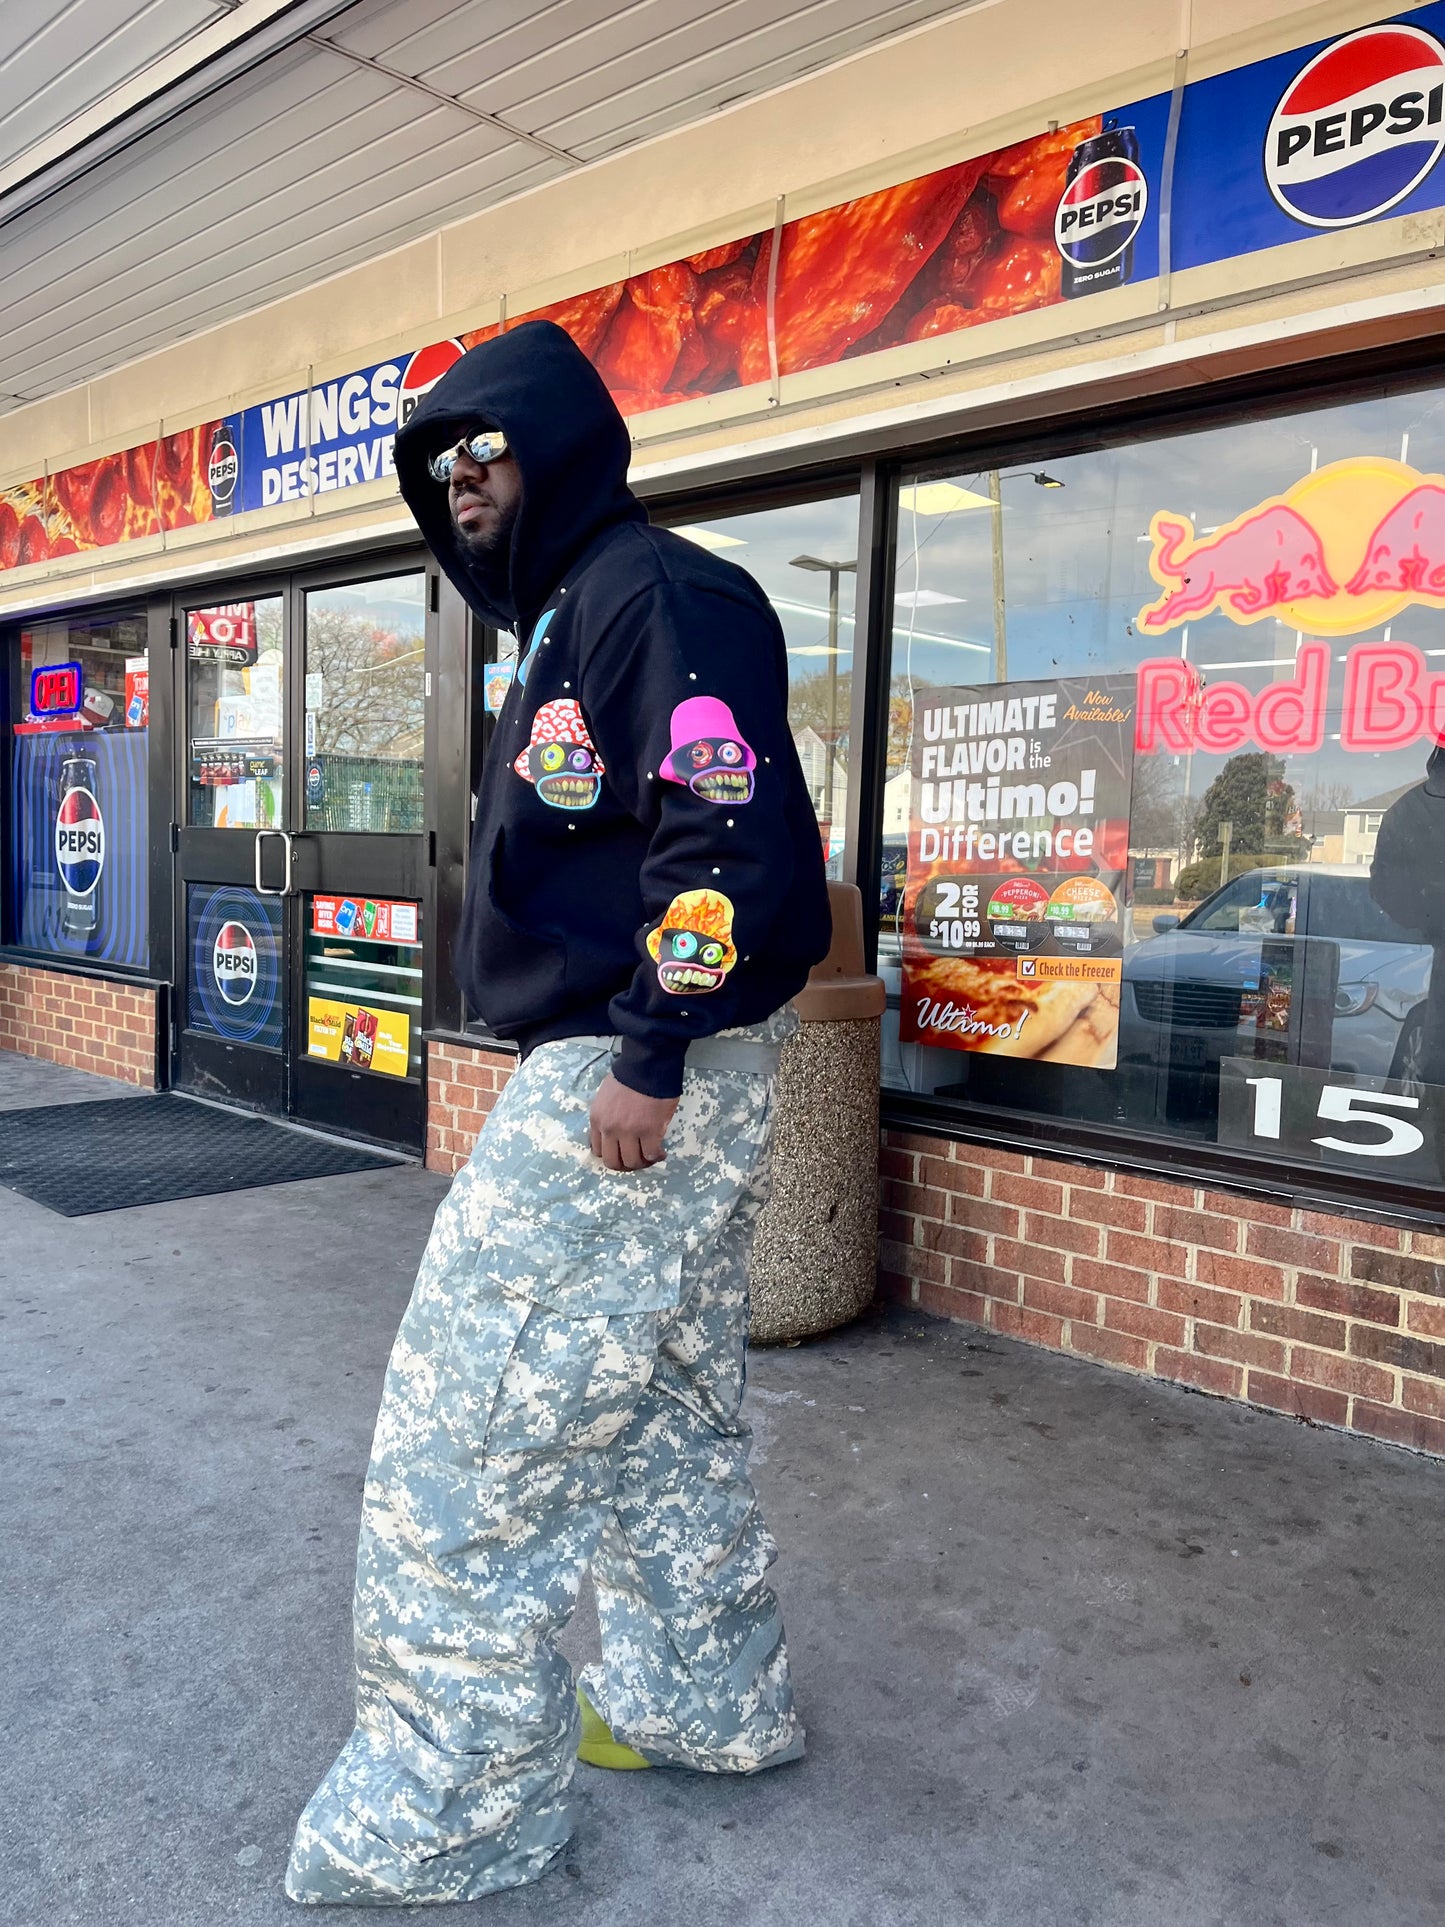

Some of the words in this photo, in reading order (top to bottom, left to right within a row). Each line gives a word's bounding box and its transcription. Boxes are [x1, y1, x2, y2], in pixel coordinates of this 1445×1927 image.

[1277, 82, 1443, 167] PEPSI
[1061, 190, 1141, 234] PEPSI
[1074, 272, 1093, 284] ZERO
[1094, 265, 1121, 279] SUGAR
[261, 364, 401, 458] WINGS
[211, 462, 236, 480] PEPSI
[35, 670, 78, 710] OPEN
[1083, 690, 1114, 705] Now
[1134, 640, 1331, 755] Red
[923, 694, 1057, 741] ULTIMATE
[1063, 704, 1132, 722] Available!
[921, 737, 1026, 778] FLAVOR
[1029, 739, 1041, 753] is
[1029, 754, 1051, 769] the
[920, 769, 1096, 824] Ultimo!
[58, 830, 101, 853] PEPSI
[919, 824, 1093, 862] Difference
[935, 882, 960, 917] 2
[962, 884, 979, 918] FOR
[1066, 887, 1101, 897] CHEESE
[216, 952, 254, 973] PEPSI
[1039, 962, 1063, 976] Check
[1065, 963, 1080, 977] the
[1082, 964, 1115, 978] Freezer
[916, 997, 1030, 1040] Ultimo!
